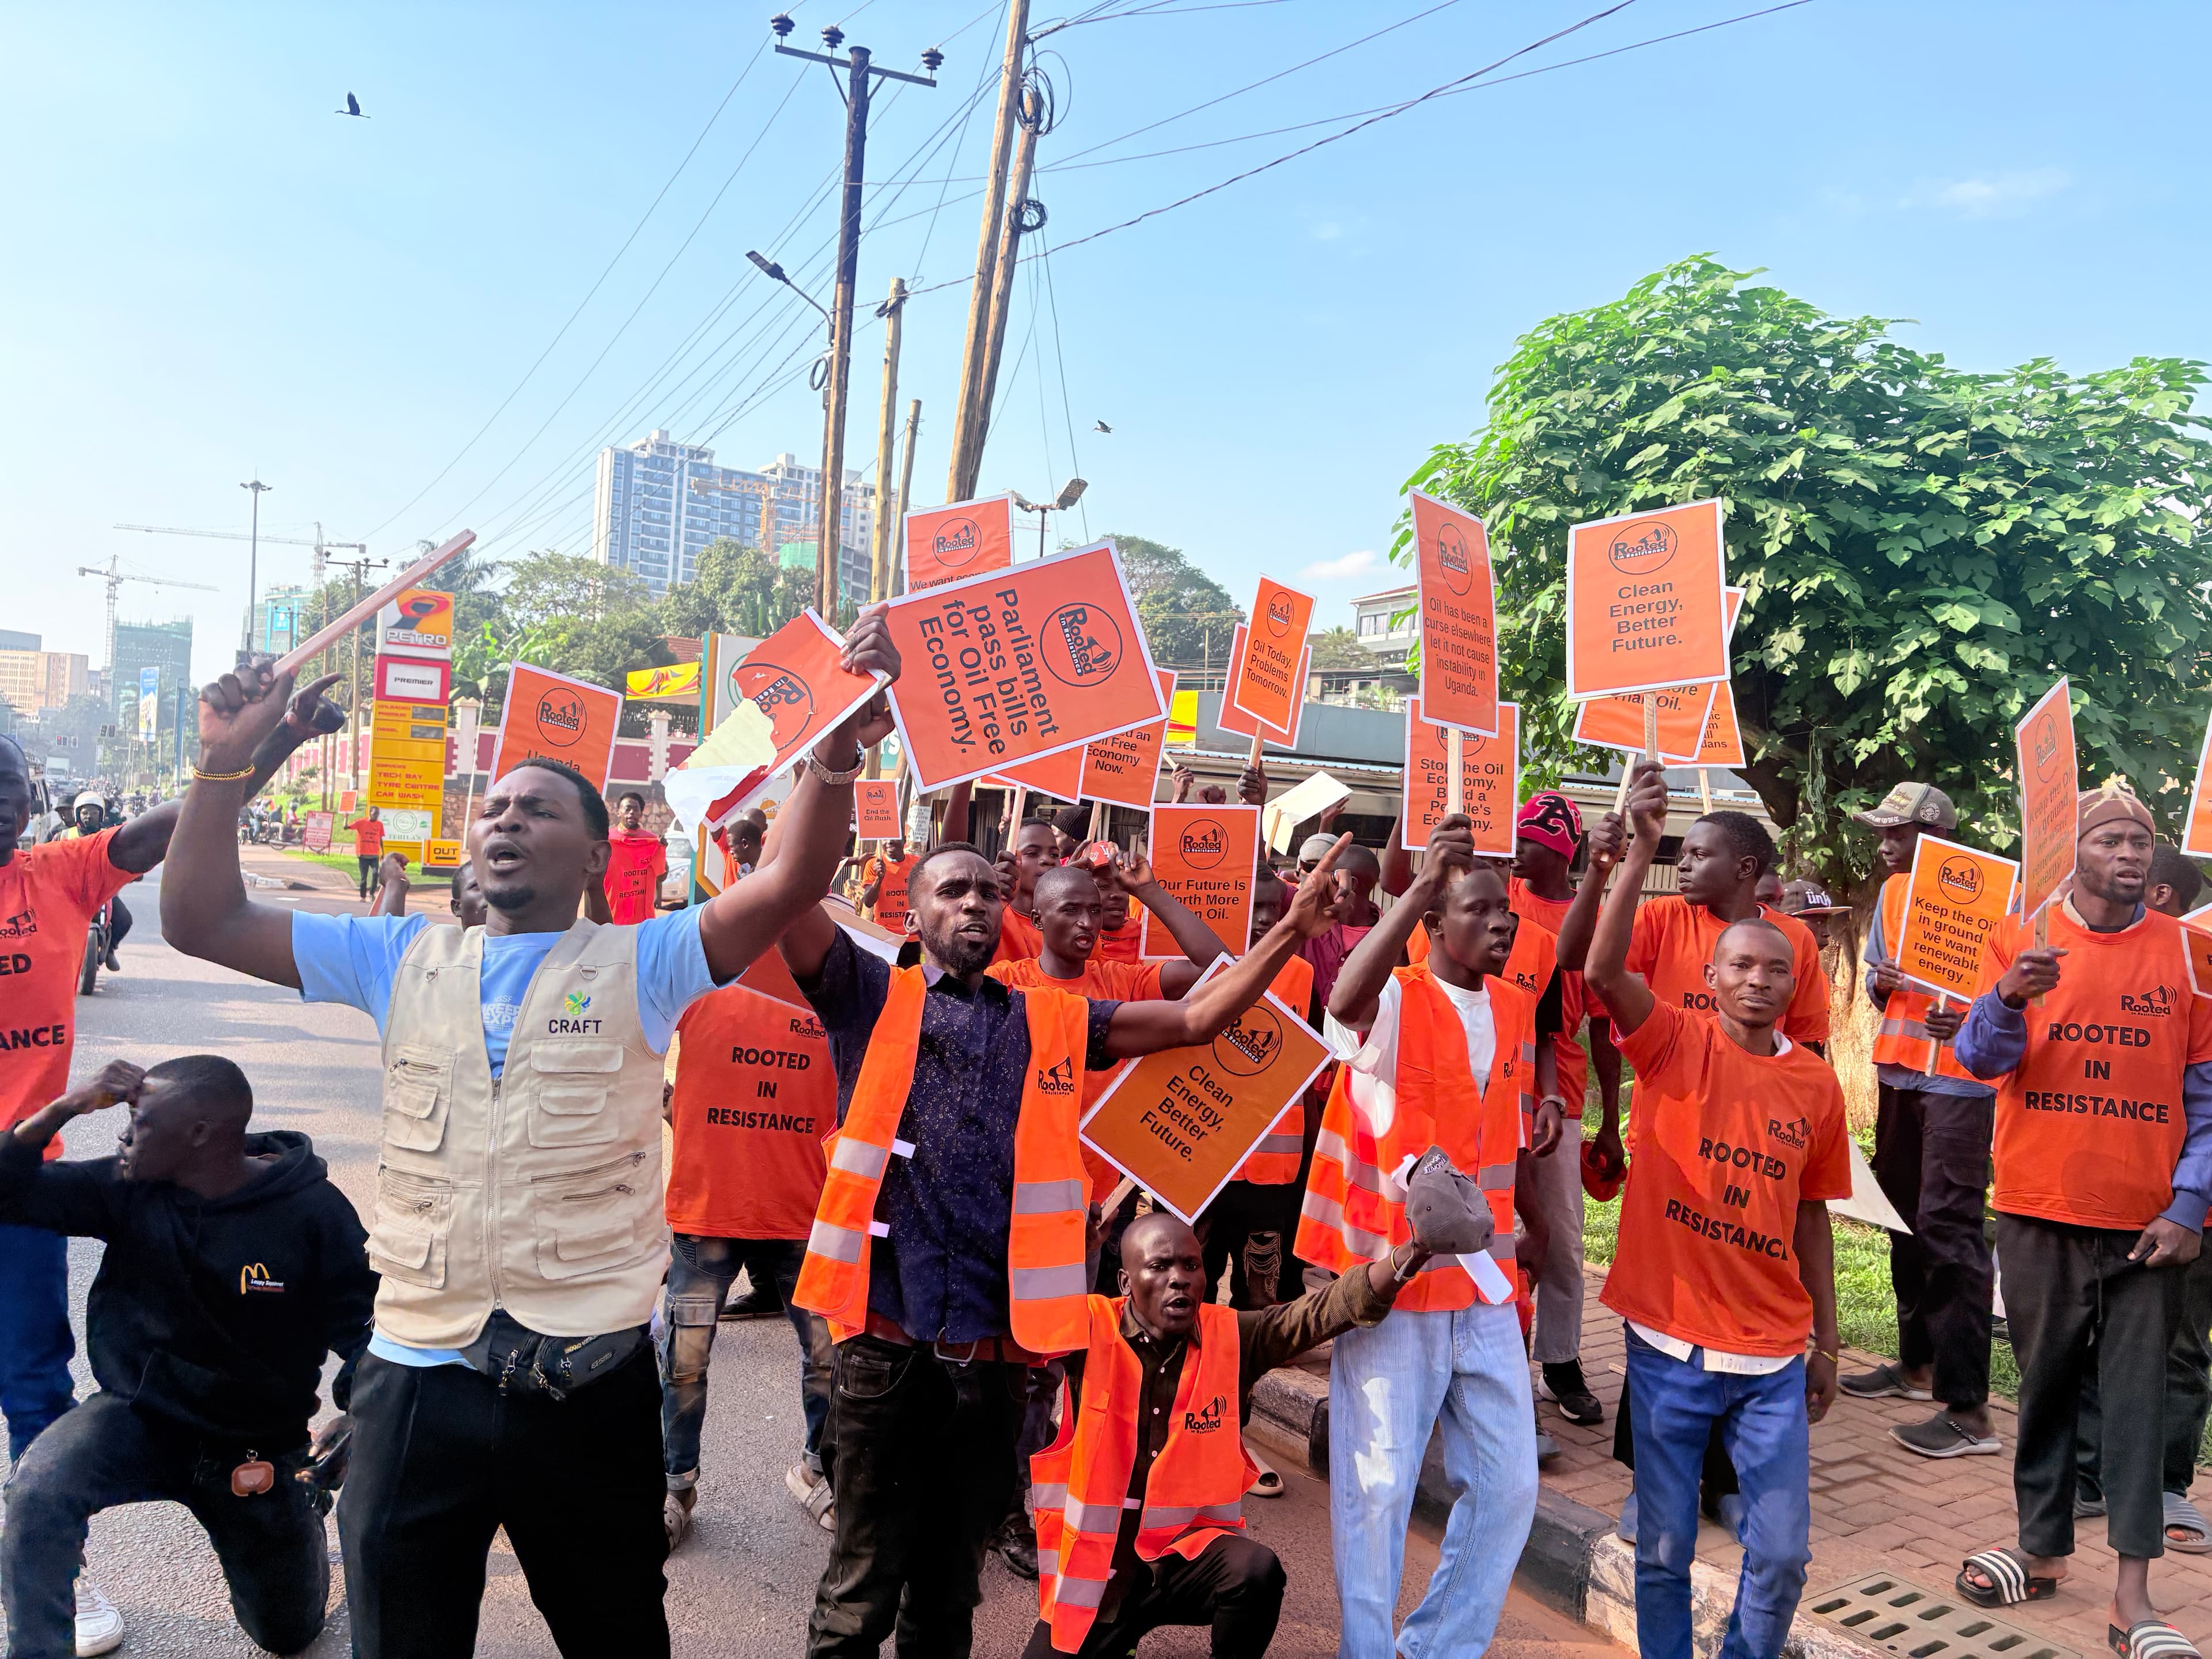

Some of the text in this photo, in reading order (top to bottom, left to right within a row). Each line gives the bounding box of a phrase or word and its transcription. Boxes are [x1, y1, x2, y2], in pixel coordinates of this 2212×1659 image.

[936, 535, 974, 551] Rooted
[1614, 538, 1667, 556] Rooted
[911, 581, 927, 590] We
[1618, 581, 1673, 599] Clean
[1430, 597, 1487, 628] Oil has been a
[1609, 598, 1683, 618] Energy,
[1425, 617, 1449, 634] curse
[1617, 616, 1677, 634] Better
[387, 630, 446, 645] PETRO
[1065, 607, 1097, 675] Rooted
[1612, 634, 1682, 652] Future.
[1253, 639, 1291, 669] Oil Today,
[1430, 634, 1489, 664] let it not cause
[967, 605, 1006, 672] pass
[997, 675, 1028, 736] bills
[995, 589, 1059, 737] Parliament
[1251, 654, 1288, 682] Problems
[1436, 654, 1486, 681] instability in
[394, 677, 433, 685] PREMIER
[918, 616, 976, 754] Economy.
[942, 600, 1005, 755] for Oil Free
[1247, 668, 1287, 698] Tomorrow.
[1445, 675, 1478, 697] Uganda.
[540, 701, 579, 726] Rooted
[1656, 695, 1681, 711] Oil.
[1111, 737, 1137, 751] Free
[1136, 732, 1150, 741] an
[1087, 744, 1141, 767] Economy
[1095, 759, 1123, 774] Now.
[1463, 761, 1480, 773] he
[1484, 763, 1503, 775] Oil
[1478, 793, 1486, 801] a
[433, 847, 458, 855] OUT
[1183, 835, 1221, 849] Rooted
[624, 869, 647, 877] ROOTED
[1942, 866, 1977, 888] Rooted
[1158, 879, 1246, 891] Our Future Is
[1206, 894, 1239, 905] More
[1206, 908, 1229, 919] Oil.
[1915, 896, 1948, 918] Keep
[1953, 910, 1973, 925] the
[1919, 912, 1930, 926] in
[0, 922, 37, 938] ooted
[1923, 930, 1978, 957] we want
[1914, 942, 1980, 972] renewable
[2121, 995, 2171, 1014] Rooted
[548, 1020, 602, 1035] CRAFT
[790, 1018, 826, 1037] Rooted
[2048, 1022, 2150, 1047] ROOTED
[732, 1047, 811, 1071] ROOTED
[2084, 1059, 2110, 1080] IN
[757, 1081, 777, 1098] IN
[1038, 1069, 1074, 1092] Rooted
[1188, 1065, 1234, 1108] Clean
[1166, 1075, 1224, 1132] Energy,
[2025, 1091, 2169, 1124] RESISTANCE
[707, 1108, 815, 1134] RESISTANCE
[1158, 1096, 1208, 1141] Better
[1139, 1110, 1192, 1162] Future.
[1768, 1119, 1805, 1149] Rooted
[1698, 1137, 1786, 1180] ROOTED
[1723, 1184, 1751, 1209] IN
[1184, 1412, 1221, 1430] Rooted
